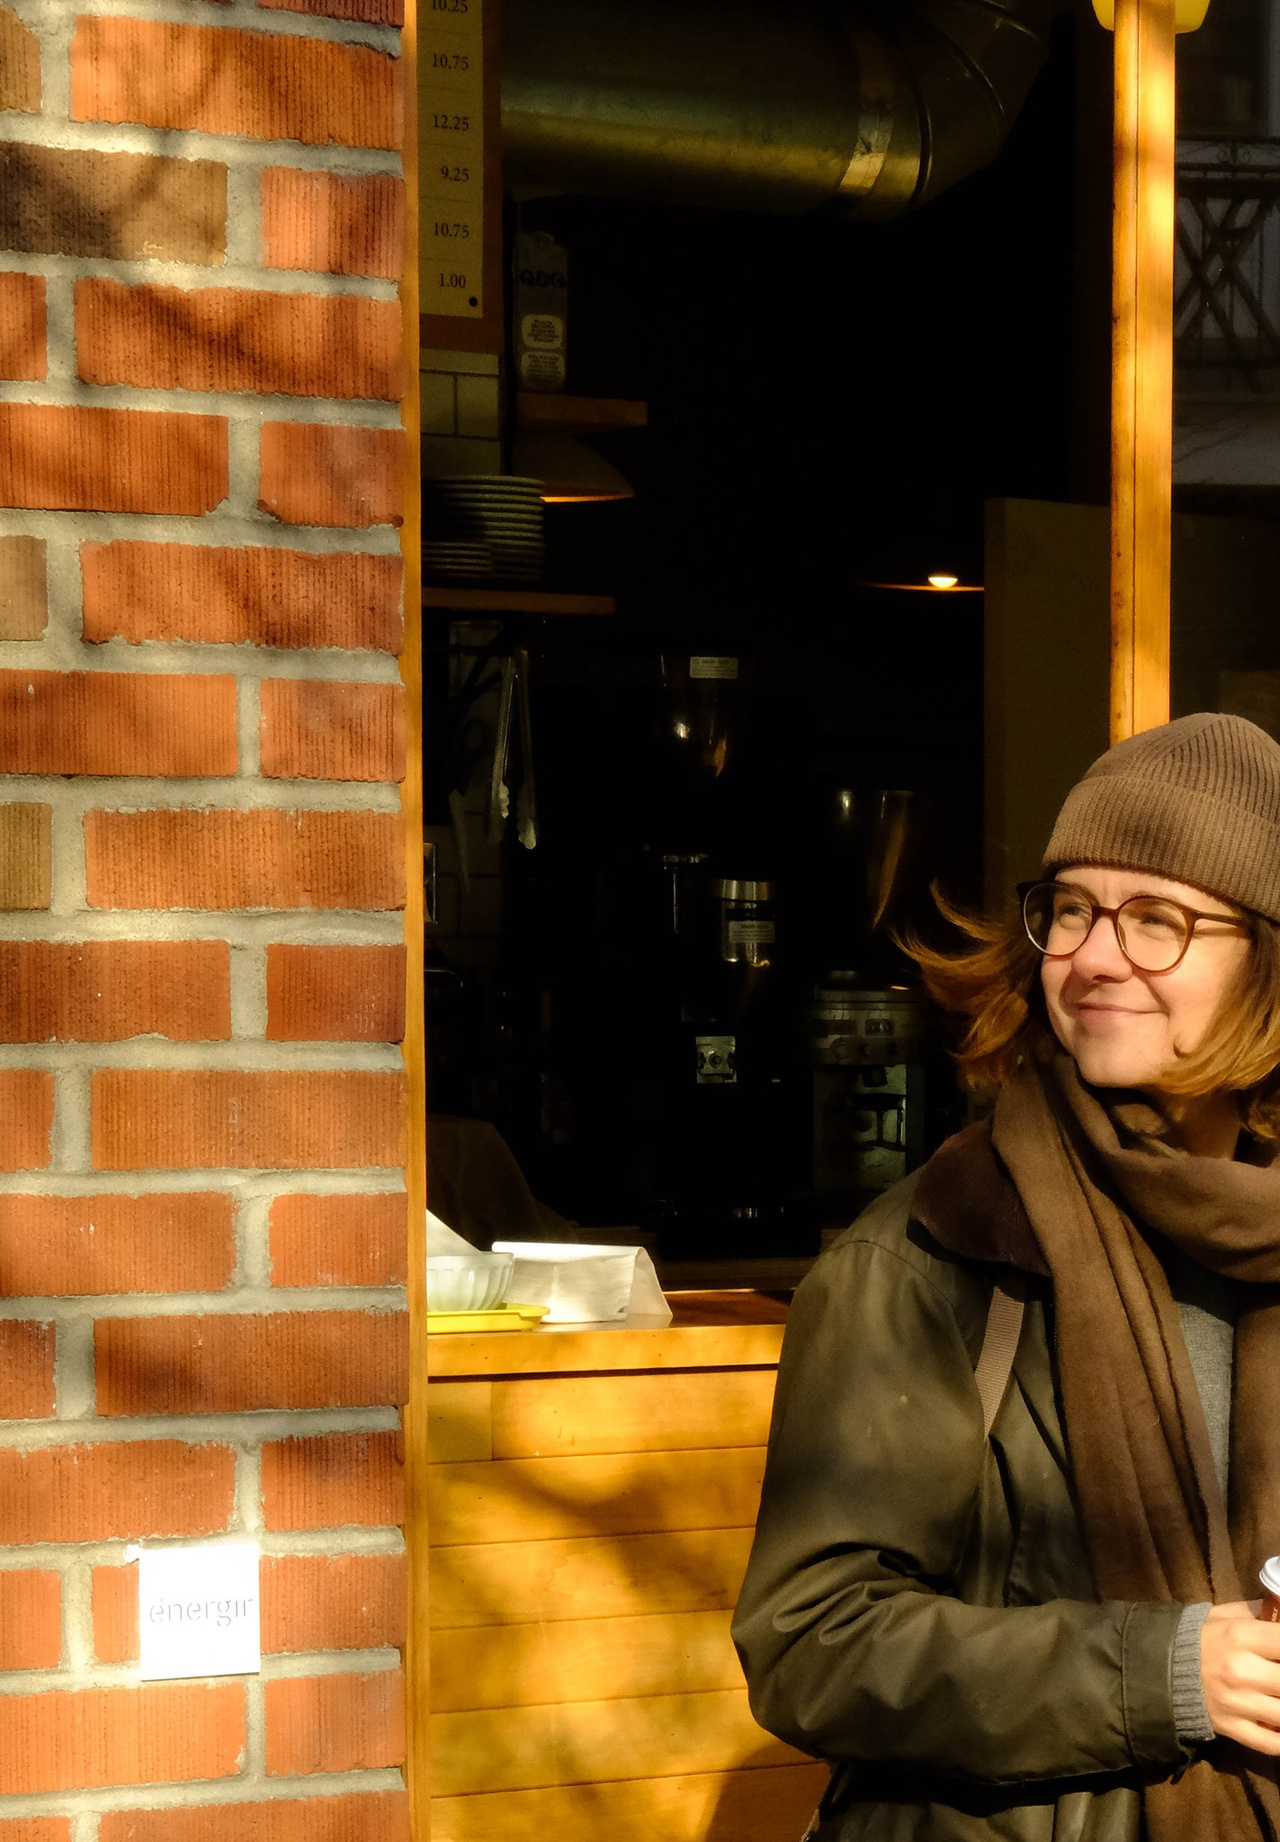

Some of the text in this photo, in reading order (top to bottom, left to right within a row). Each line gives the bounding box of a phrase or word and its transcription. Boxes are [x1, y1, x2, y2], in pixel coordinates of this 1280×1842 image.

[432, 0, 468, 14] 10.25
[432, 53, 469, 71] 10.75
[433, 114, 470, 131] 12.25
[441, 166, 470, 182] 9.25
[433, 222, 470, 239] 10.75
[439, 273, 466, 289] 1.00
